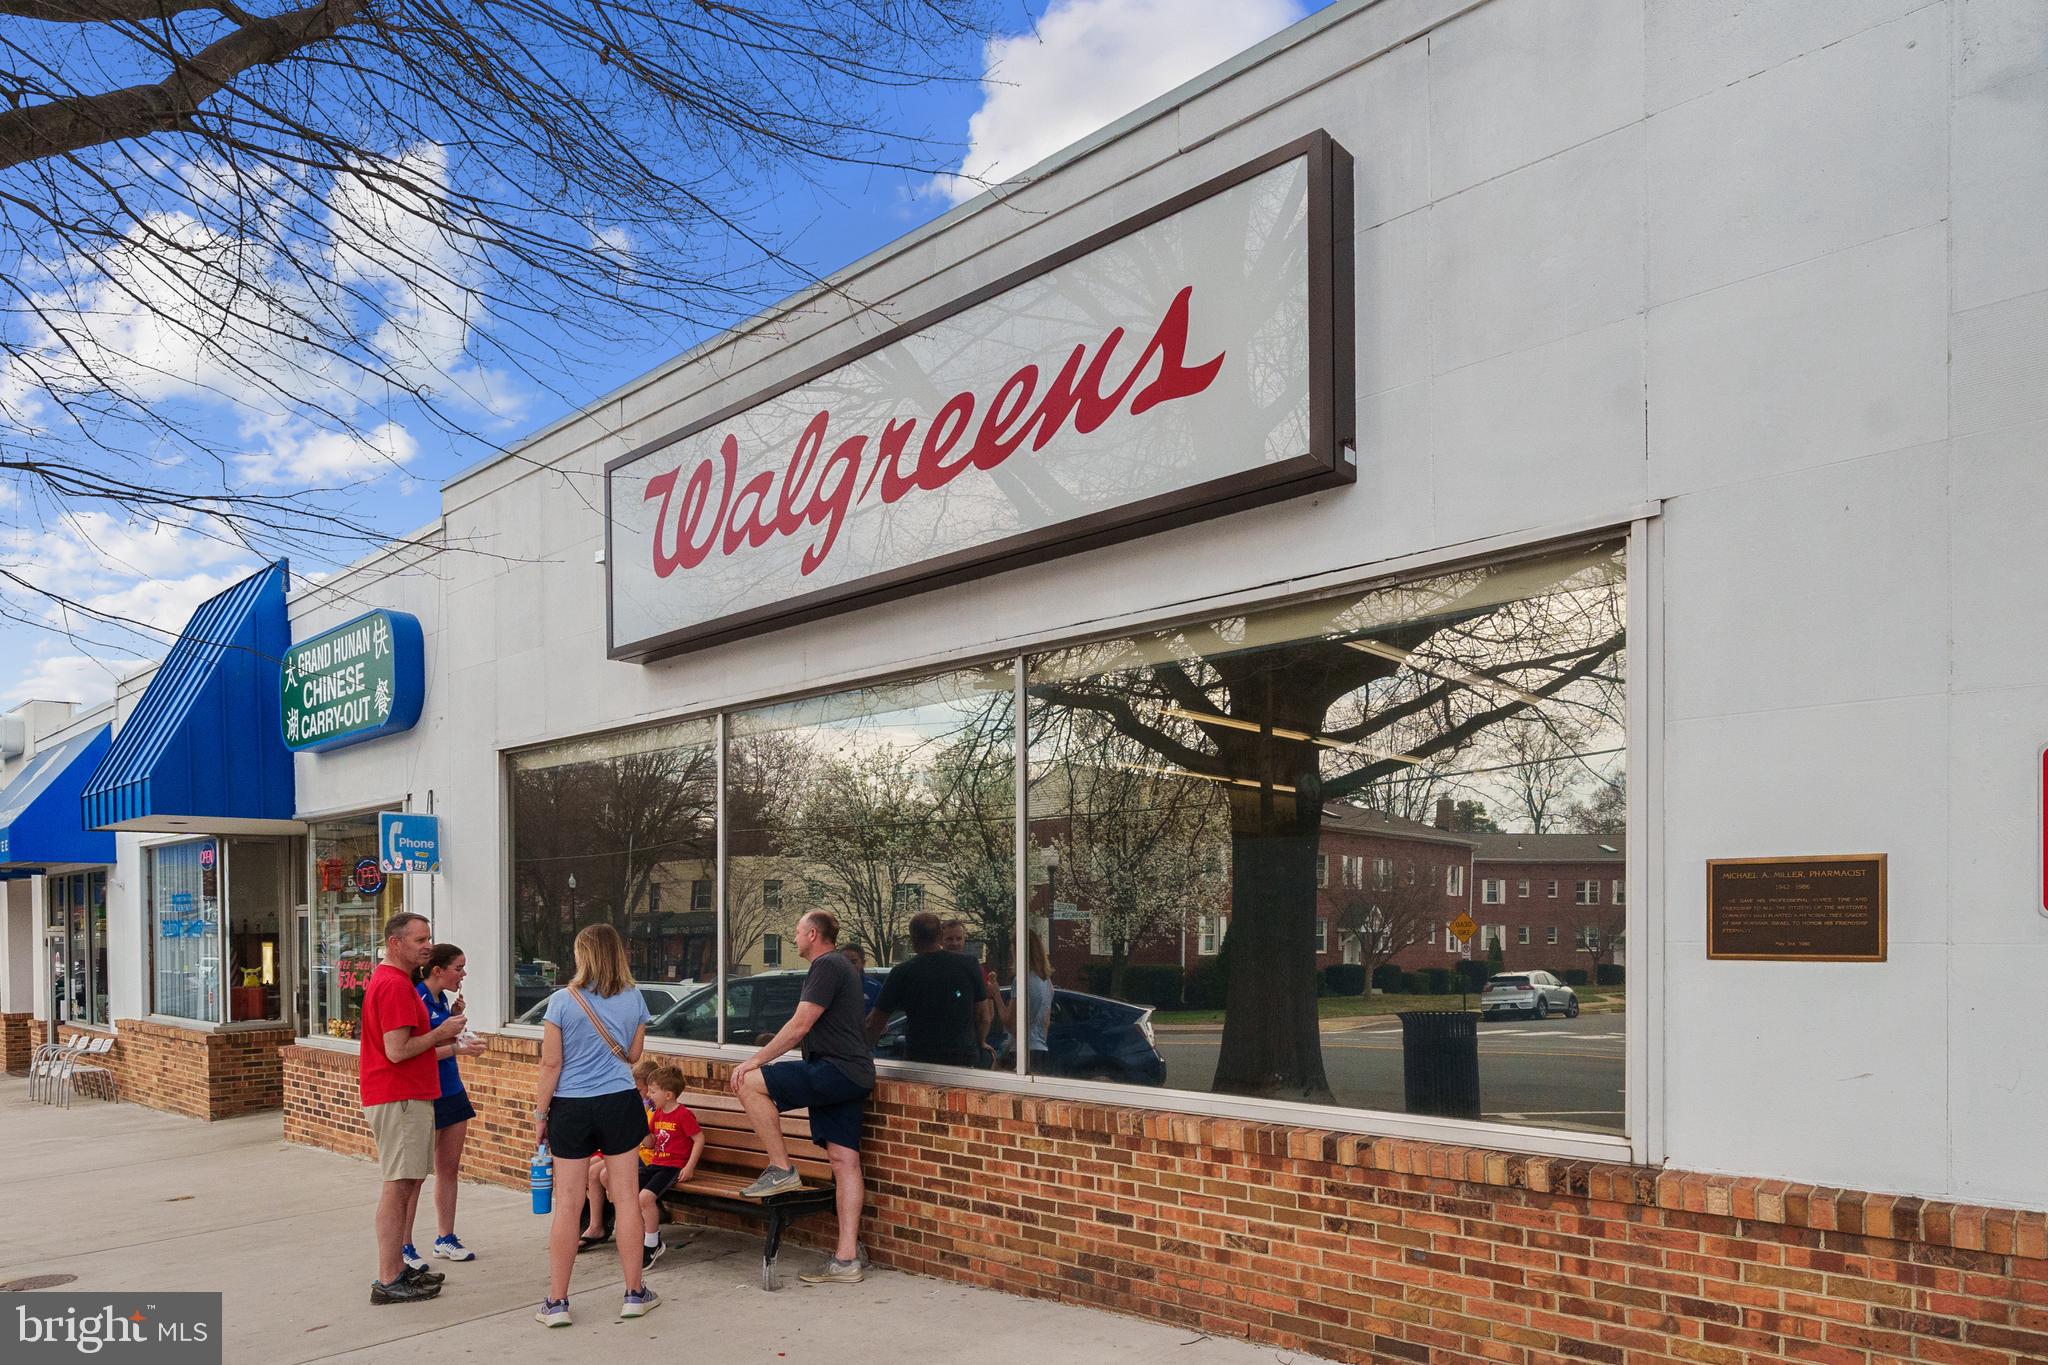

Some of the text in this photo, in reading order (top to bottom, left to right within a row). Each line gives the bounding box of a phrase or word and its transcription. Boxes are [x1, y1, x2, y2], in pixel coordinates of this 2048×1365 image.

[644, 285, 1225, 579] Walgreens
[298, 626, 370, 678] GRAND HUNAN
[303, 662, 365, 708] CHINESE
[301, 696, 371, 739] CARRY-OUT
[399, 838, 435, 849] Phone
[200, 850, 213, 864] OPEN
[357, 866, 381, 887] OPEN
[1722, 872, 1757, 880] MICHAEL
[1761, 871, 1770, 879] A.
[1809, 869, 1868, 878] PHARMACIST
[337, 971, 370, 990] 536-6
